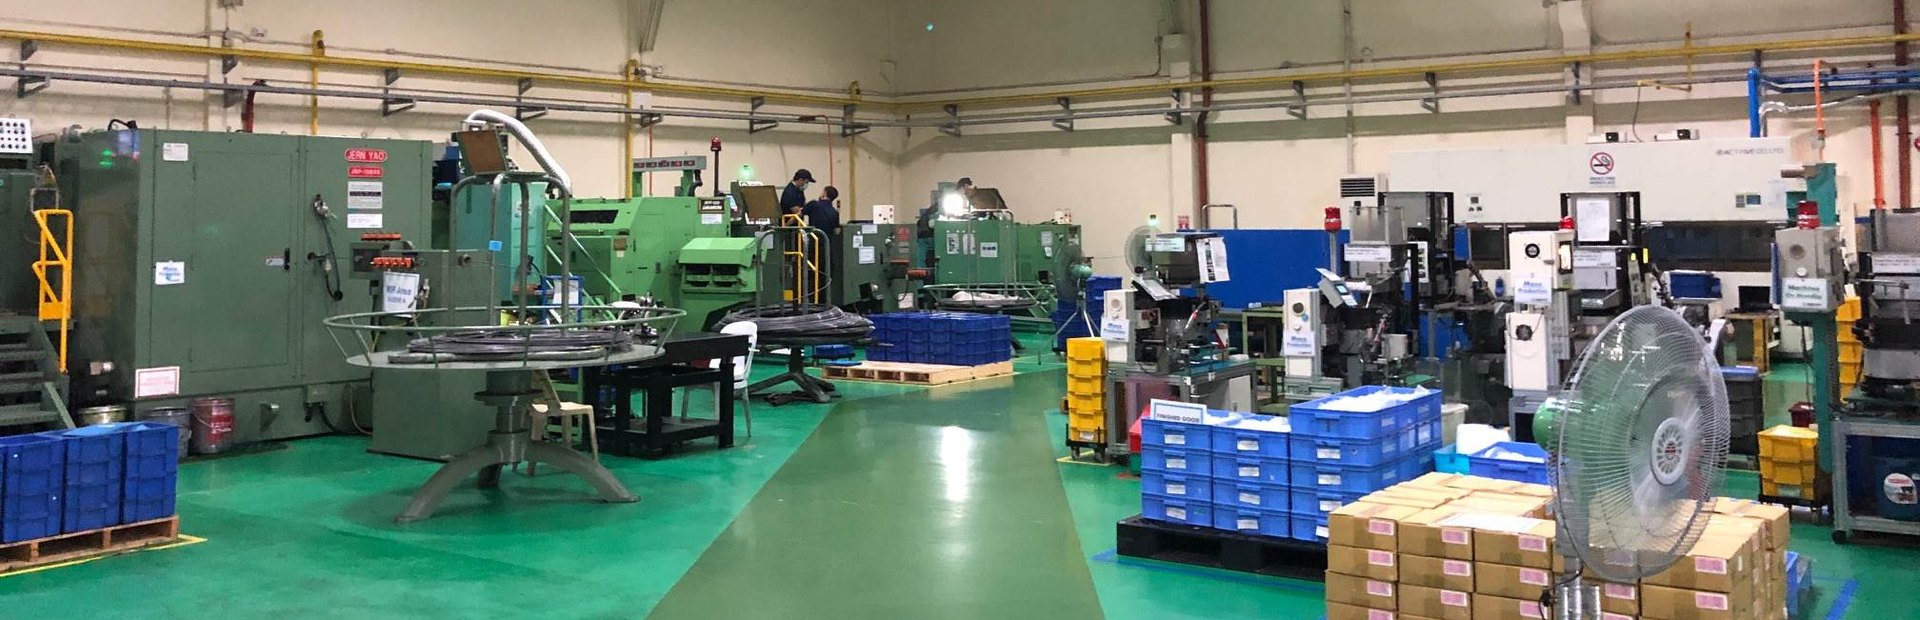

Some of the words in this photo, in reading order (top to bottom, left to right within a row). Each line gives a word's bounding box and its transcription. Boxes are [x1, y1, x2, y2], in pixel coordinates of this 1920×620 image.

[348, 150, 366, 160] JERN
[368, 151, 385, 161] YAO
[1156, 413, 1181, 421] FINISHED
